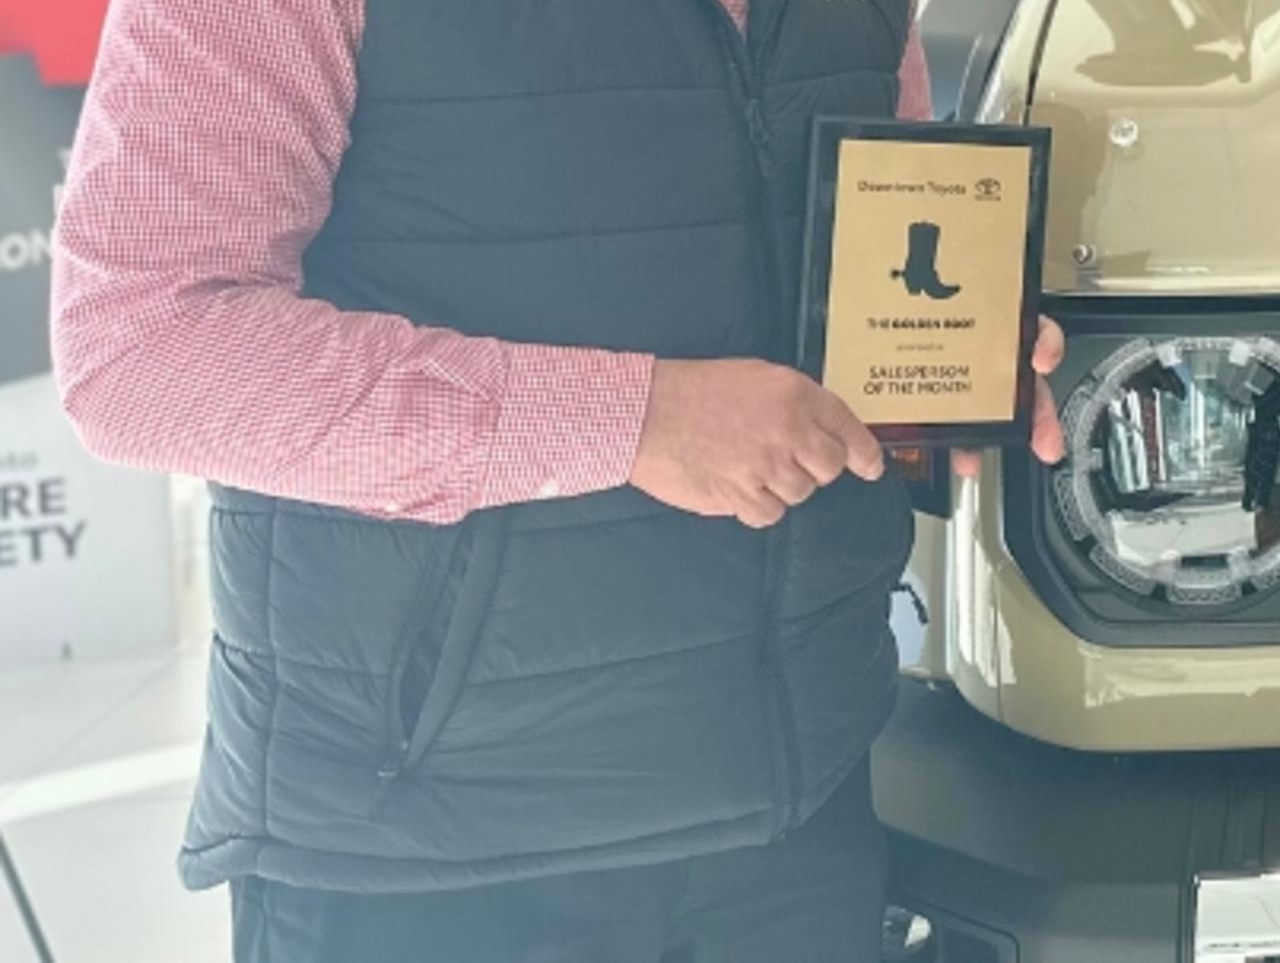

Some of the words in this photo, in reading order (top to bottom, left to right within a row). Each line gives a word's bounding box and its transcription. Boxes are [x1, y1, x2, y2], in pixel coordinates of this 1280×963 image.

[869, 365, 970, 379] SALESPERSON
[863, 381, 884, 395] OF
[888, 381, 914, 395] THE
[917, 380, 972, 395] MONTH
